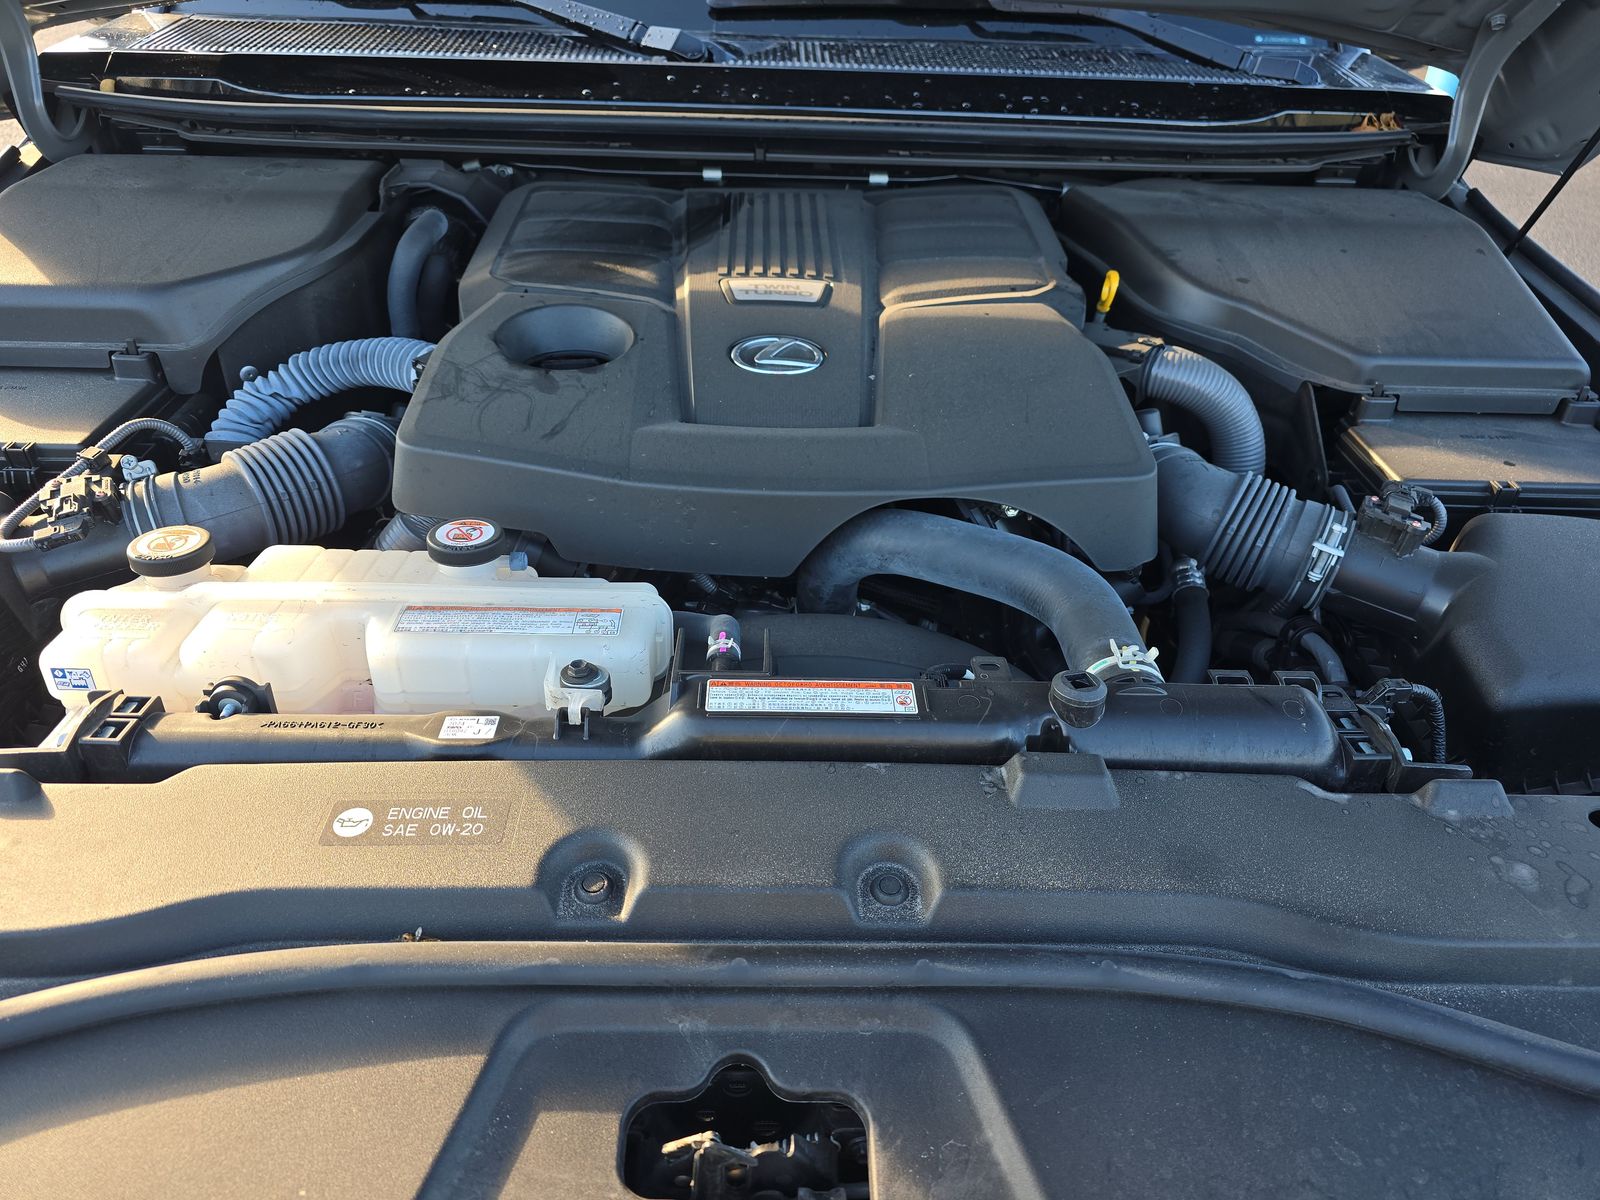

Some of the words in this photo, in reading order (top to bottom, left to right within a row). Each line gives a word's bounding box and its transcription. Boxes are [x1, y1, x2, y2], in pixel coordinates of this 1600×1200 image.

[387, 806, 451, 820] ENGINE
[461, 806, 488, 819] OIL
[382, 823, 419, 837] SAE
[429, 822, 485, 837] 0W-20
